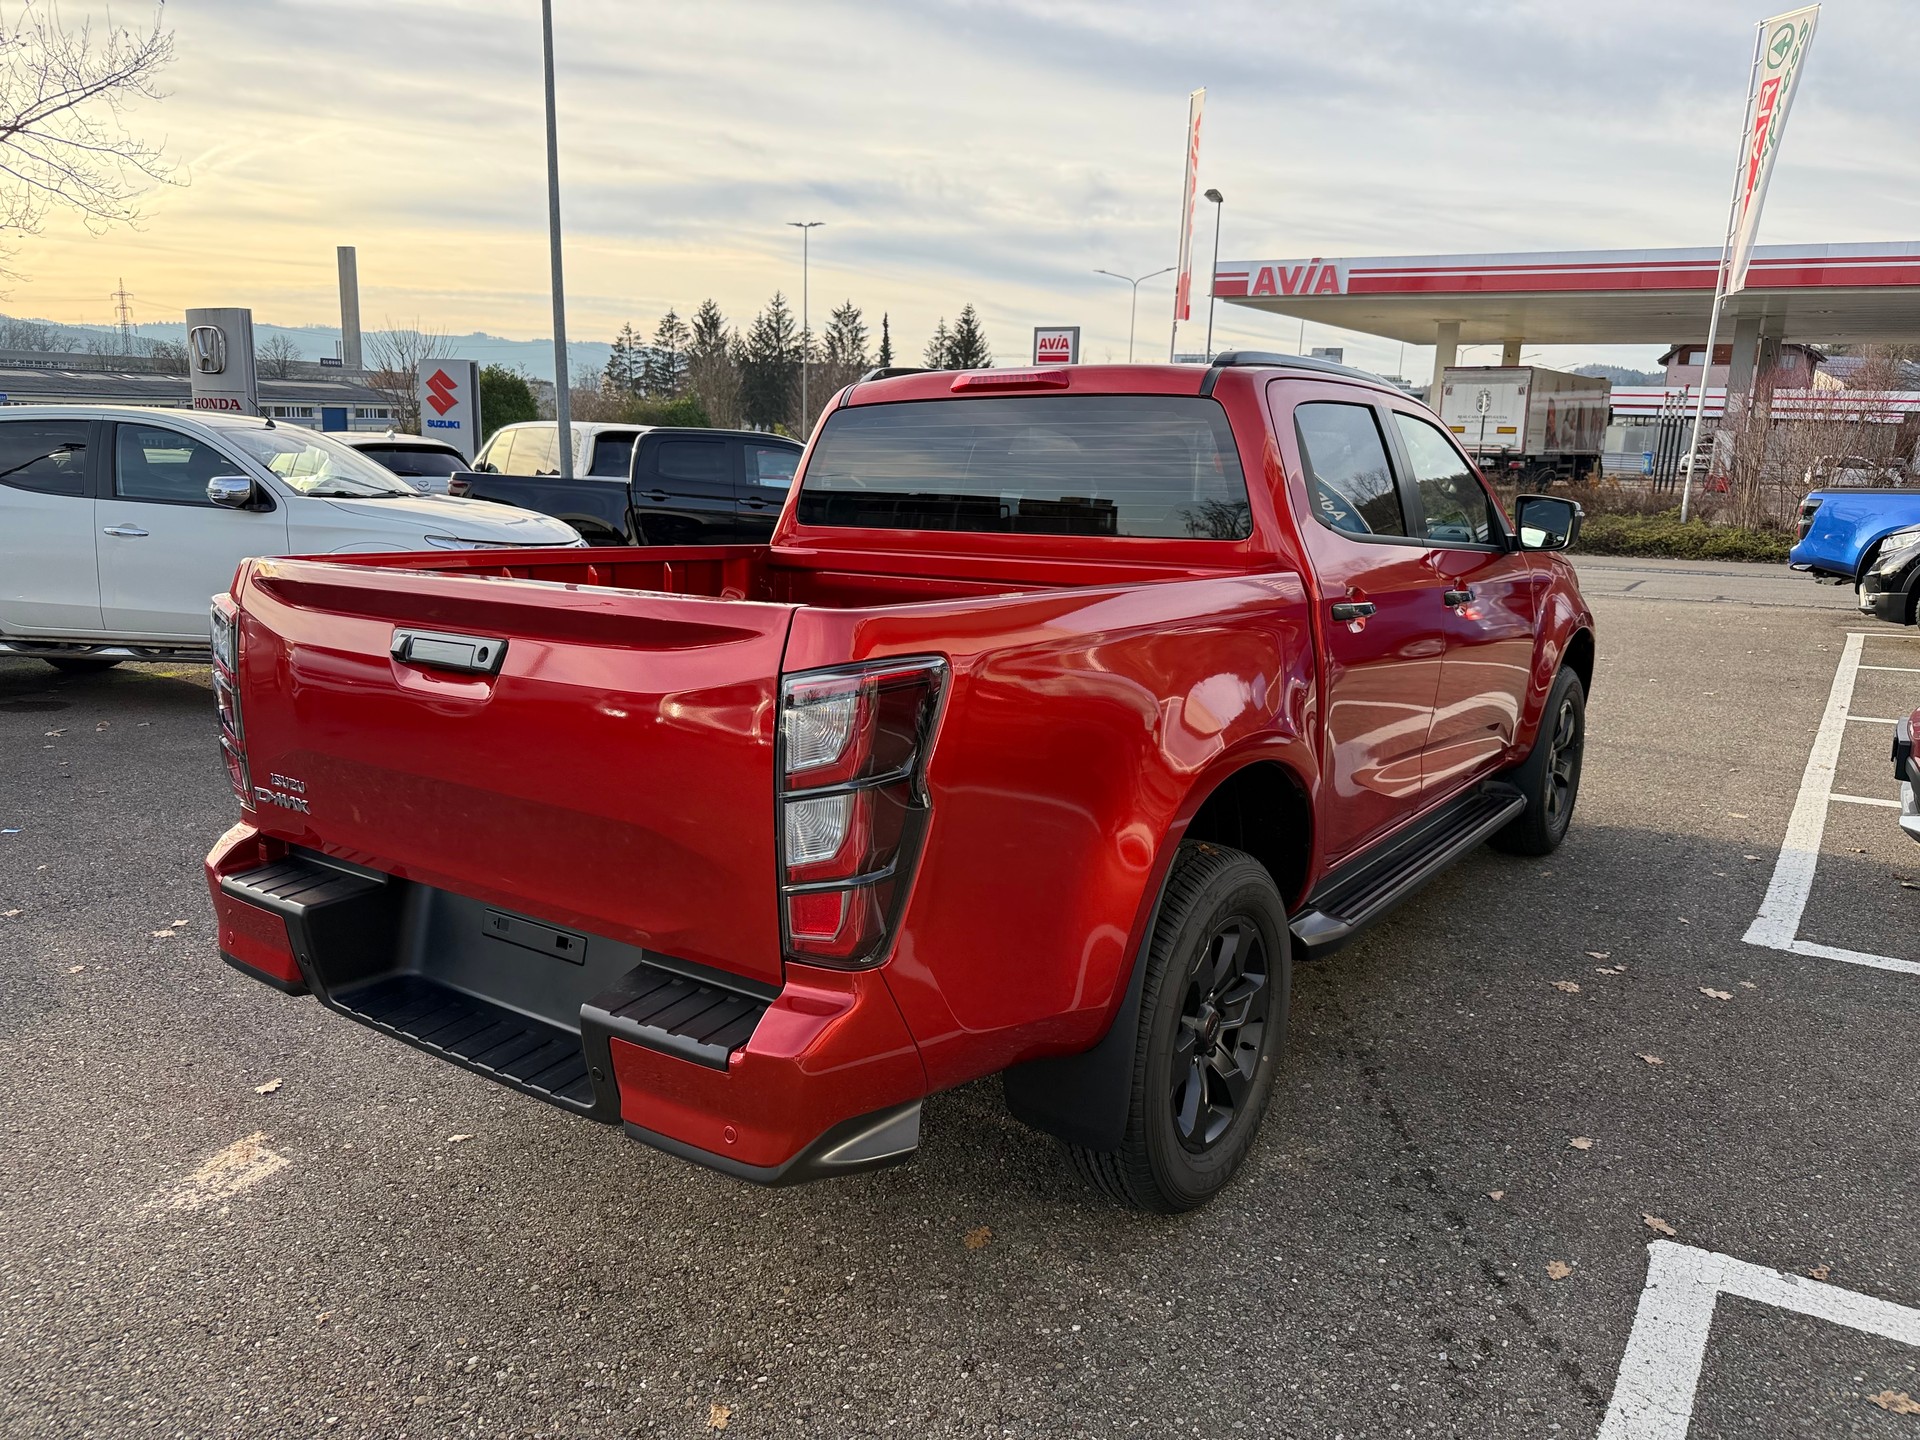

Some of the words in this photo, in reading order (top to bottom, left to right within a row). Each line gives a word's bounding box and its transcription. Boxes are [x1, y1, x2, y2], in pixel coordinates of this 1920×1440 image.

[1251, 257, 1340, 296] AVIA
[1038, 334, 1070, 350] AVIA
[193, 397, 243, 411] HONDA
[427, 419, 461, 429] SUZUKI
[270, 772, 307, 794] ISUZU
